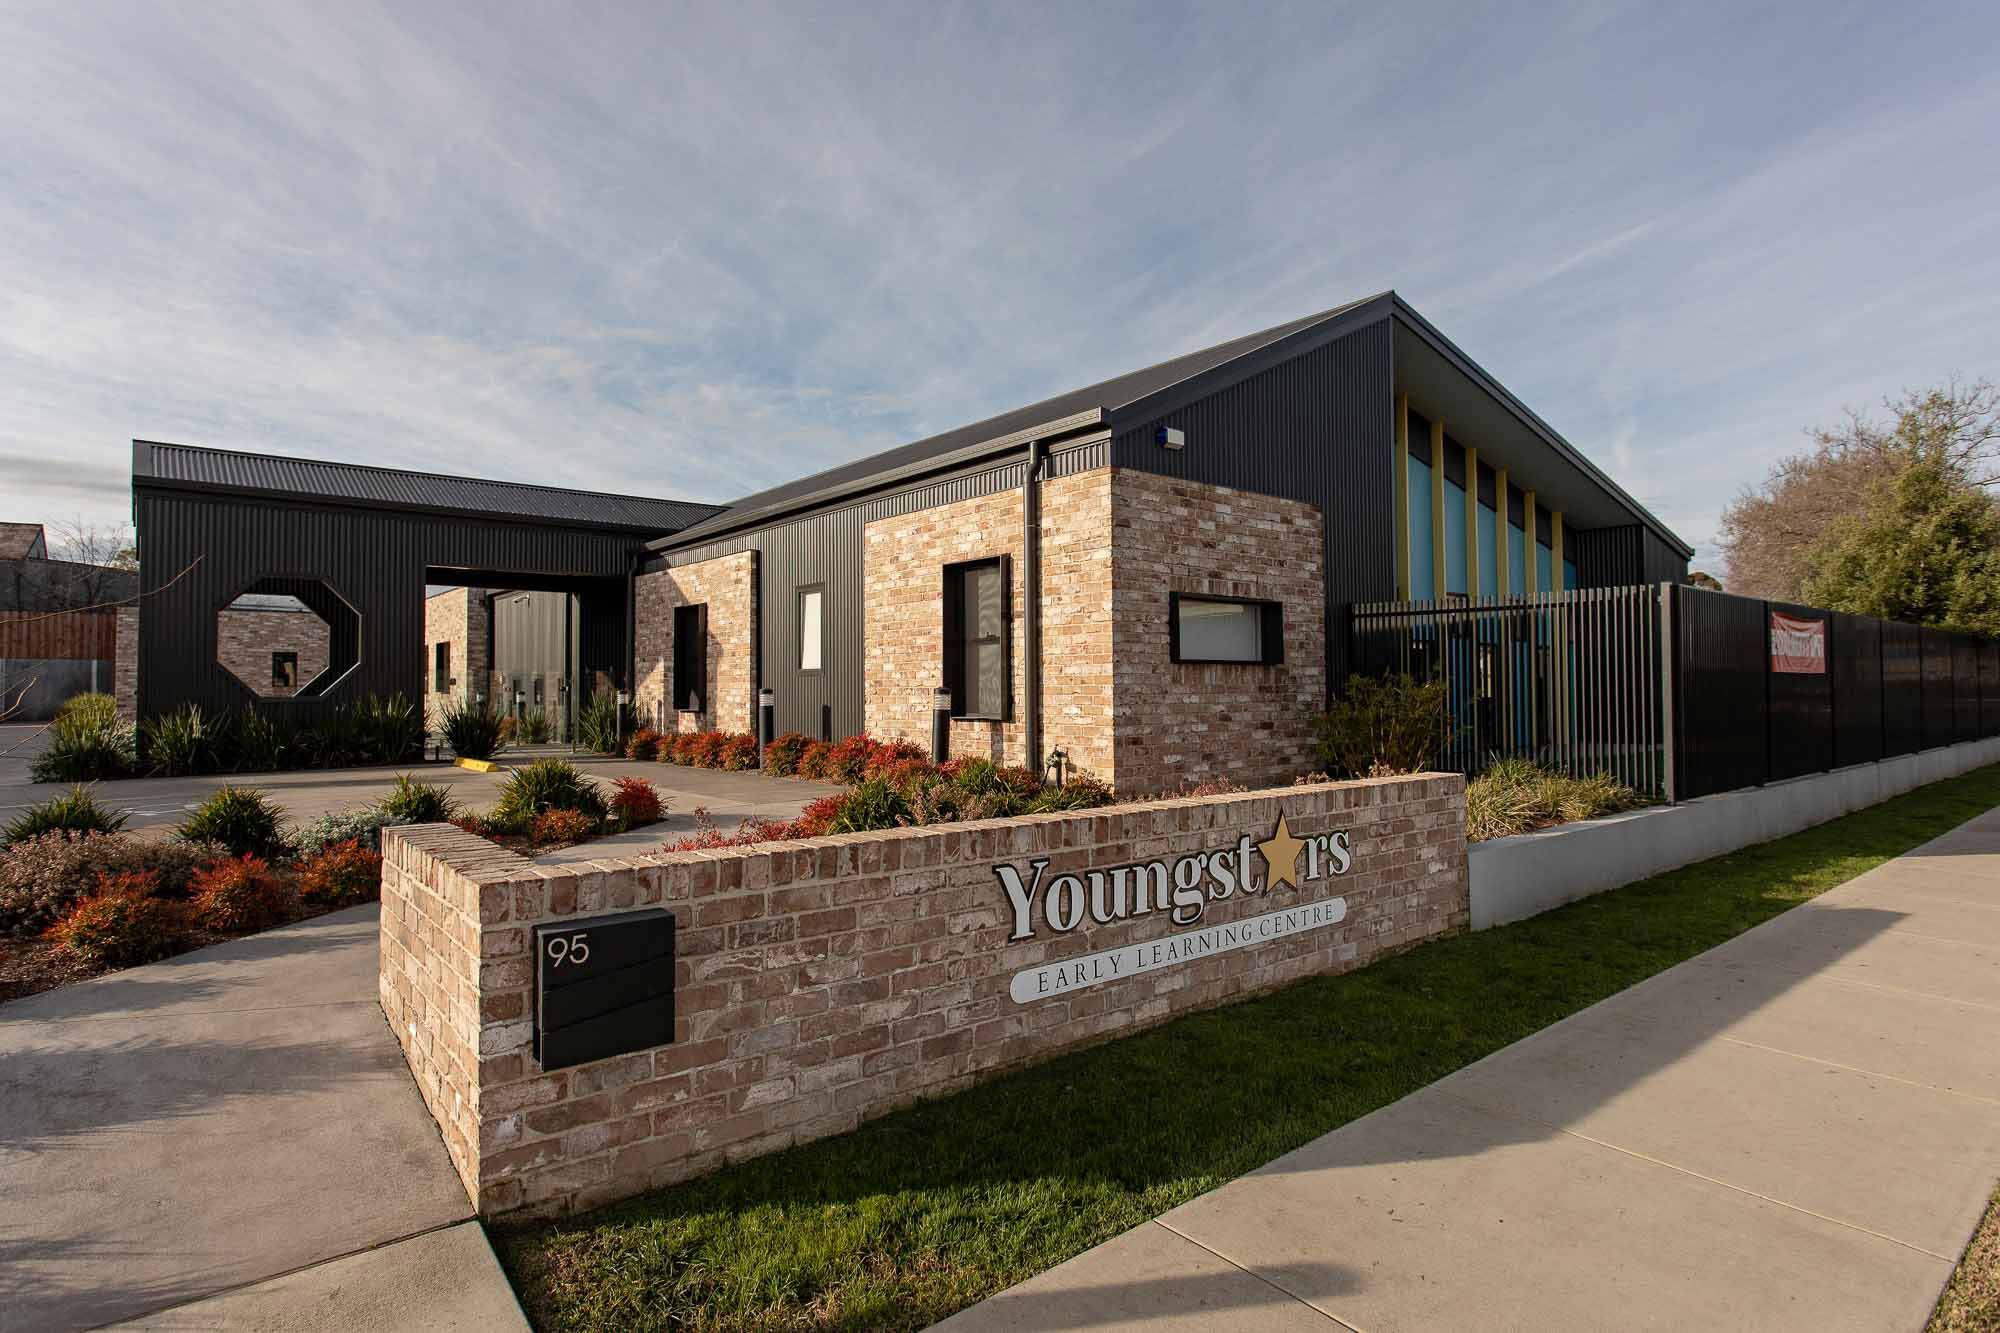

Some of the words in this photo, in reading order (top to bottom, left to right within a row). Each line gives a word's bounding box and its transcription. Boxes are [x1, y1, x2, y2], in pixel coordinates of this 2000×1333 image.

[993, 809, 1352, 943] Youngstrs
[548, 934, 590, 968] 95
[1037, 953, 1122, 993] EARLY
[1136, 923, 1254, 969] LEARNING
[1258, 903, 1335, 938] CENTRE
